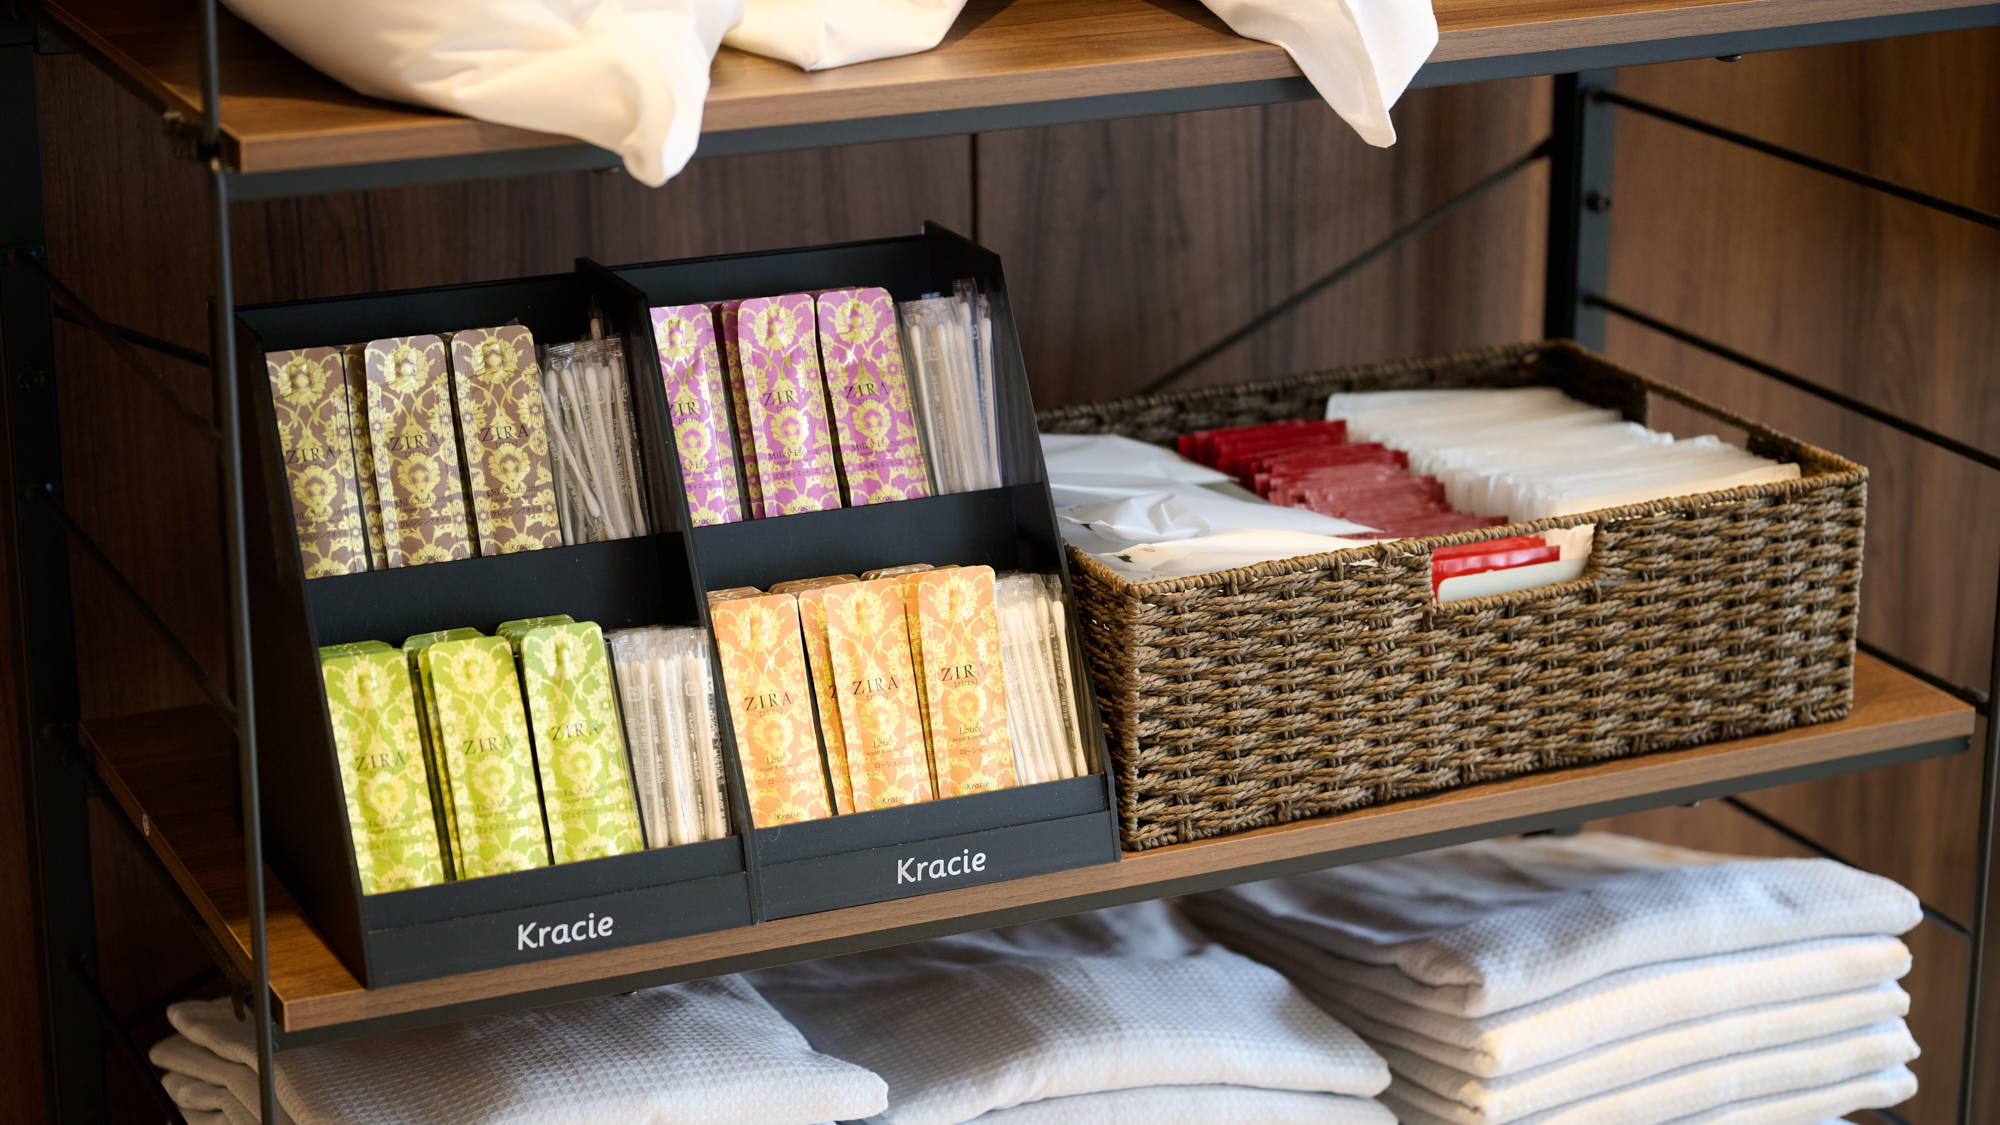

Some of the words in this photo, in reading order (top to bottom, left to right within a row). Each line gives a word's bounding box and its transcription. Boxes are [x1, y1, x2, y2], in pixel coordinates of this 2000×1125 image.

[390, 432, 440, 451] ZIRA
[481, 423, 529, 442] ZIRA
[285, 447, 336, 464] ZIRA
[941, 664, 986, 682] ZIRA
[852, 676, 898, 695] ZIRA
[744, 692, 792, 711] ZIRA
[552, 720, 600, 741] ZIRA
[959, 725, 984, 735] Lotion
[463, 736, 513, 755] ZIRA
[873, 739, 896, 748] Loti
[355, 751, 405, 771] ZIRA
[766, 754, 788, 765] Lotio
[966, 781, 990, 790] Kracie
[897, 848, 987, 885] Kracie
[517, 912, 614, 951] Kracie
